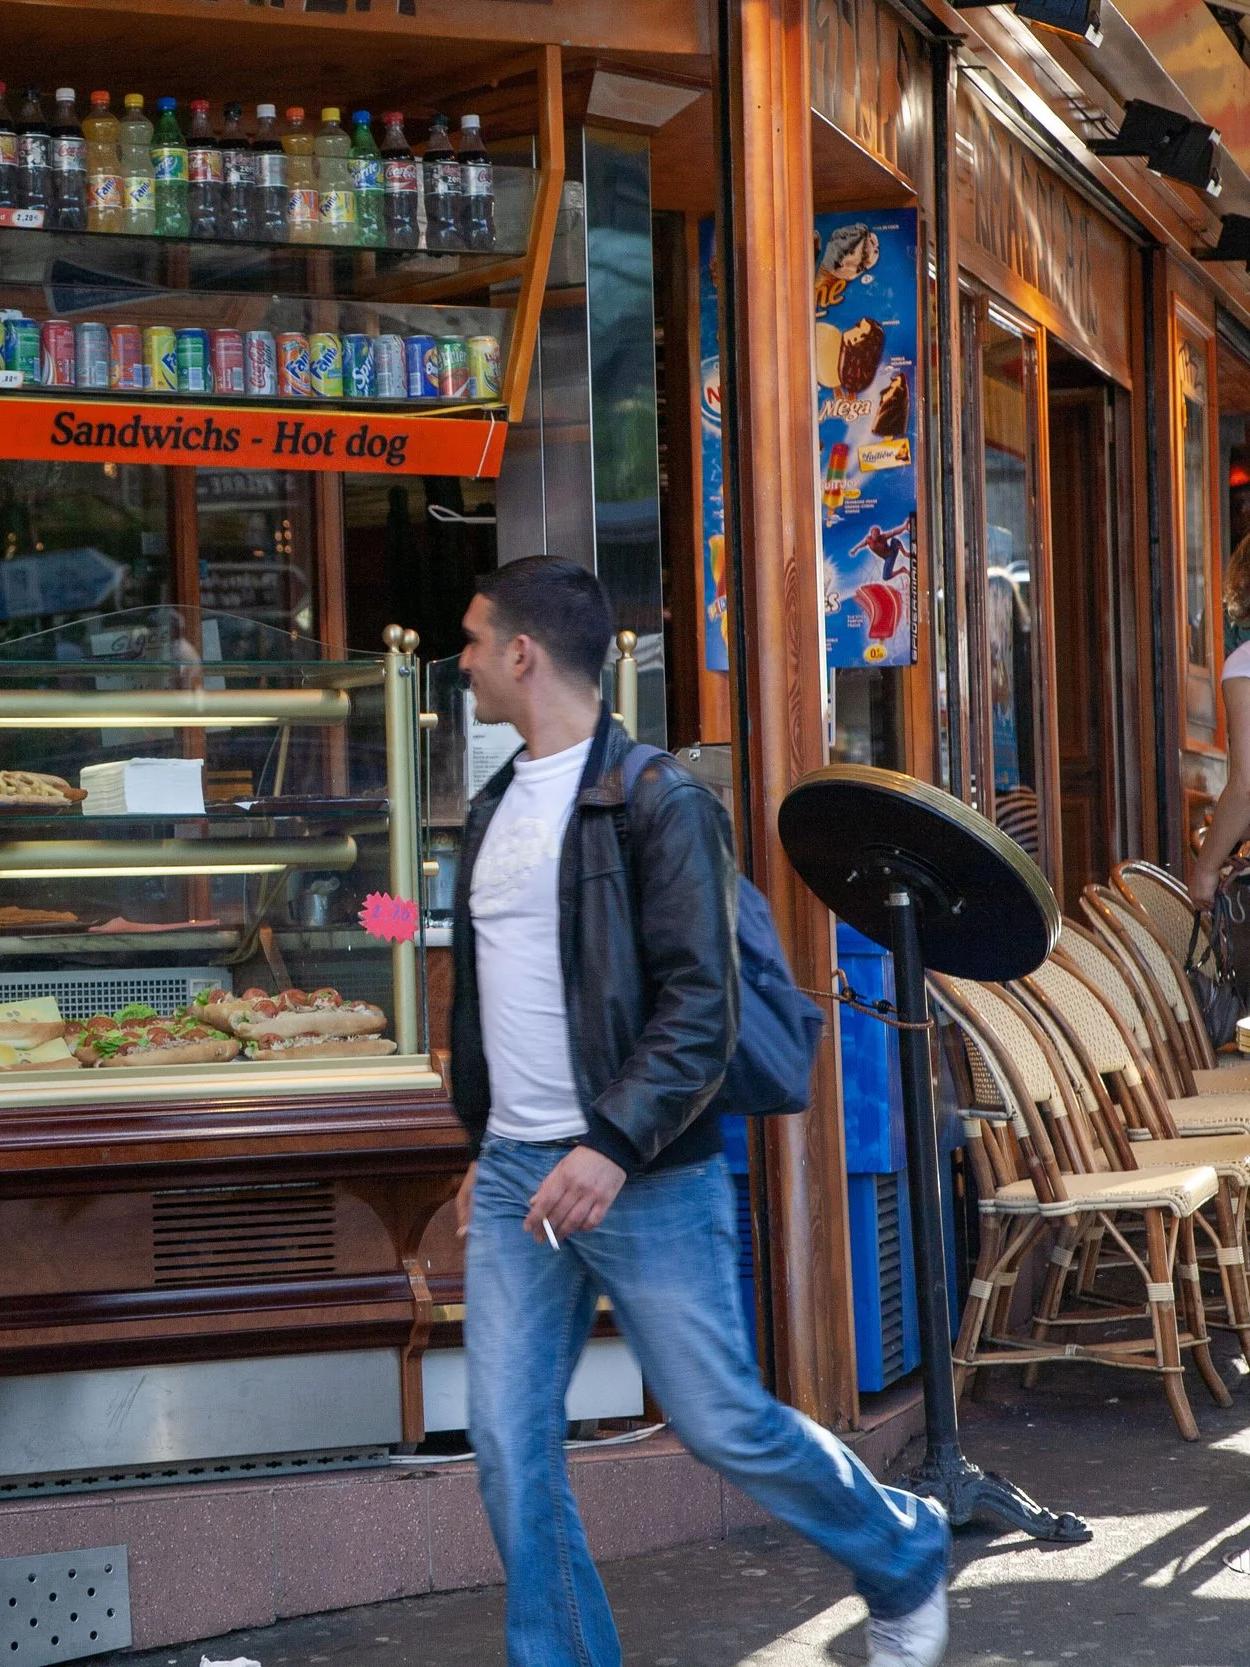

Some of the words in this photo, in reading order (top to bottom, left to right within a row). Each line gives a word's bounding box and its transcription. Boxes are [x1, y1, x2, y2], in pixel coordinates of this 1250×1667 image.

[818, 399, 872, 422] Mega
[51, 411, 241, 452] Sandwichs
[272, 420, 338, 456] Hot
[345, 424, 409, 467] dog
